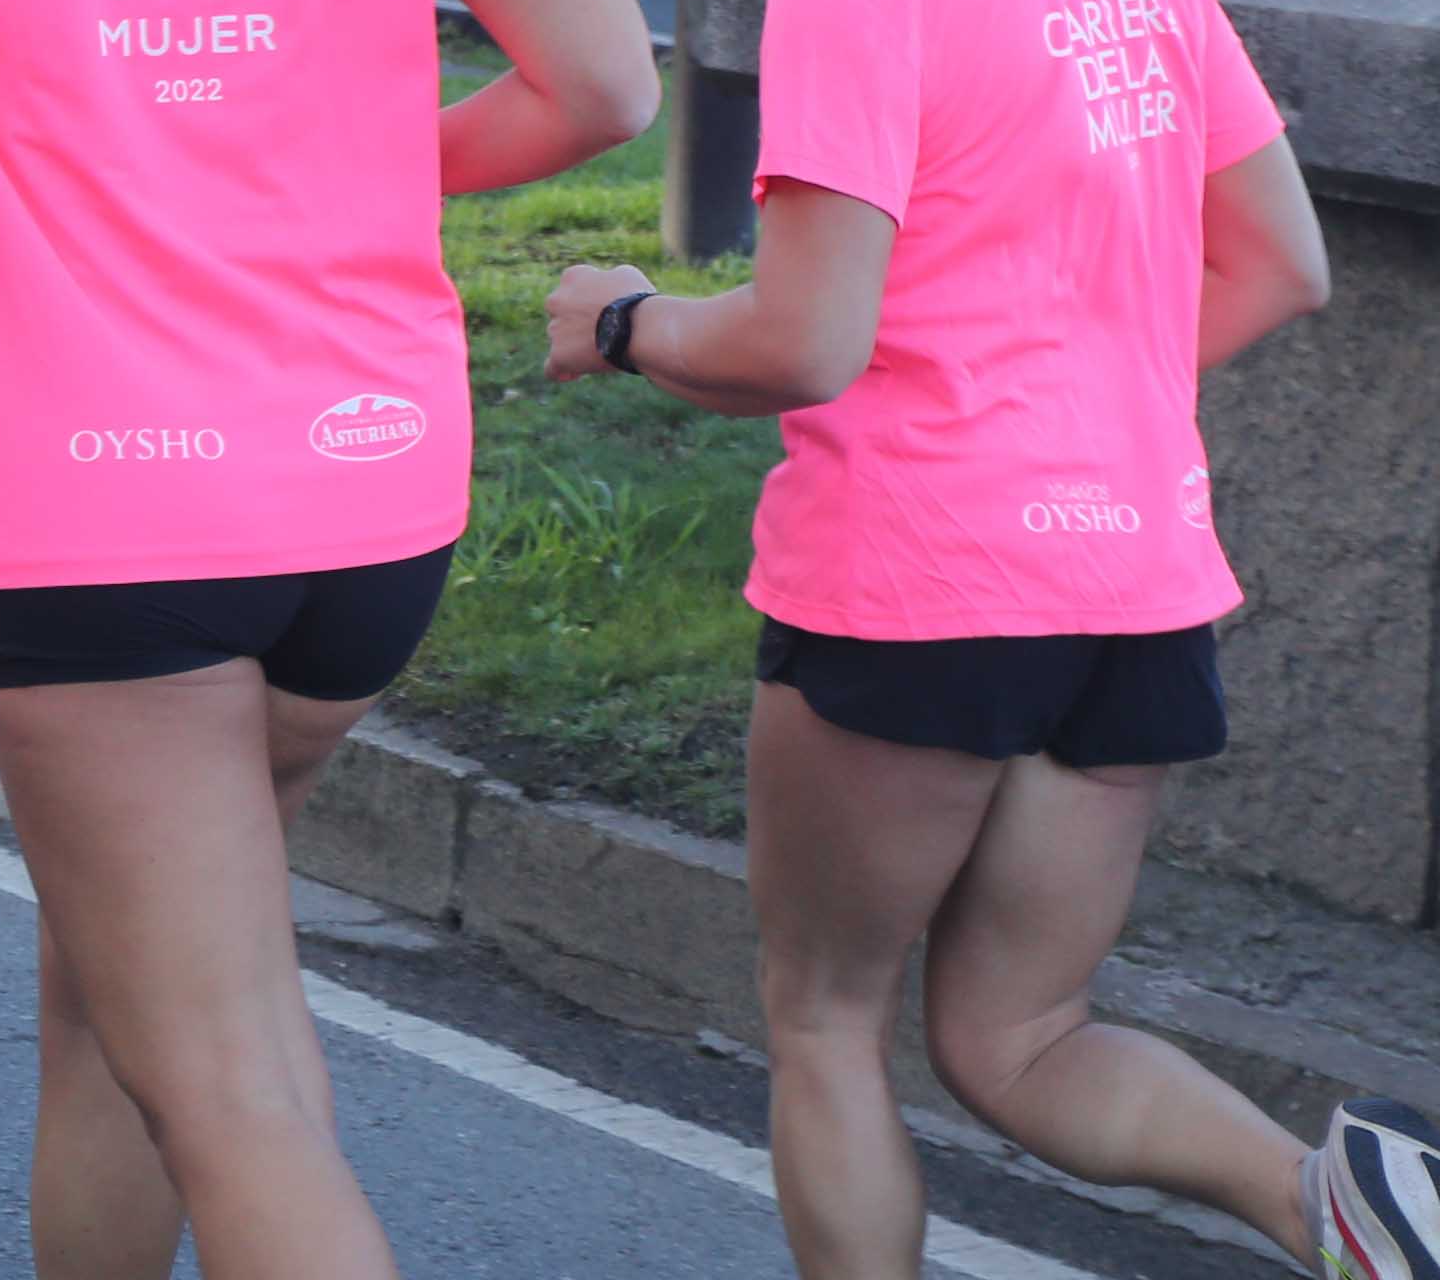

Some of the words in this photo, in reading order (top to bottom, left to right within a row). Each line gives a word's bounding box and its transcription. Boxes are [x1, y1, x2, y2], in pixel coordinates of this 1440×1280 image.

[97, 13, 277, 57] MUJER
[1075, 49, 1121, 102] DE
[1119, 41, 1169, 90] LA
[154, 77, 224, 104] 2022
[69, 428, 225, 463] OYSHO
[1023, 503, 1141, 534] OYSHO
